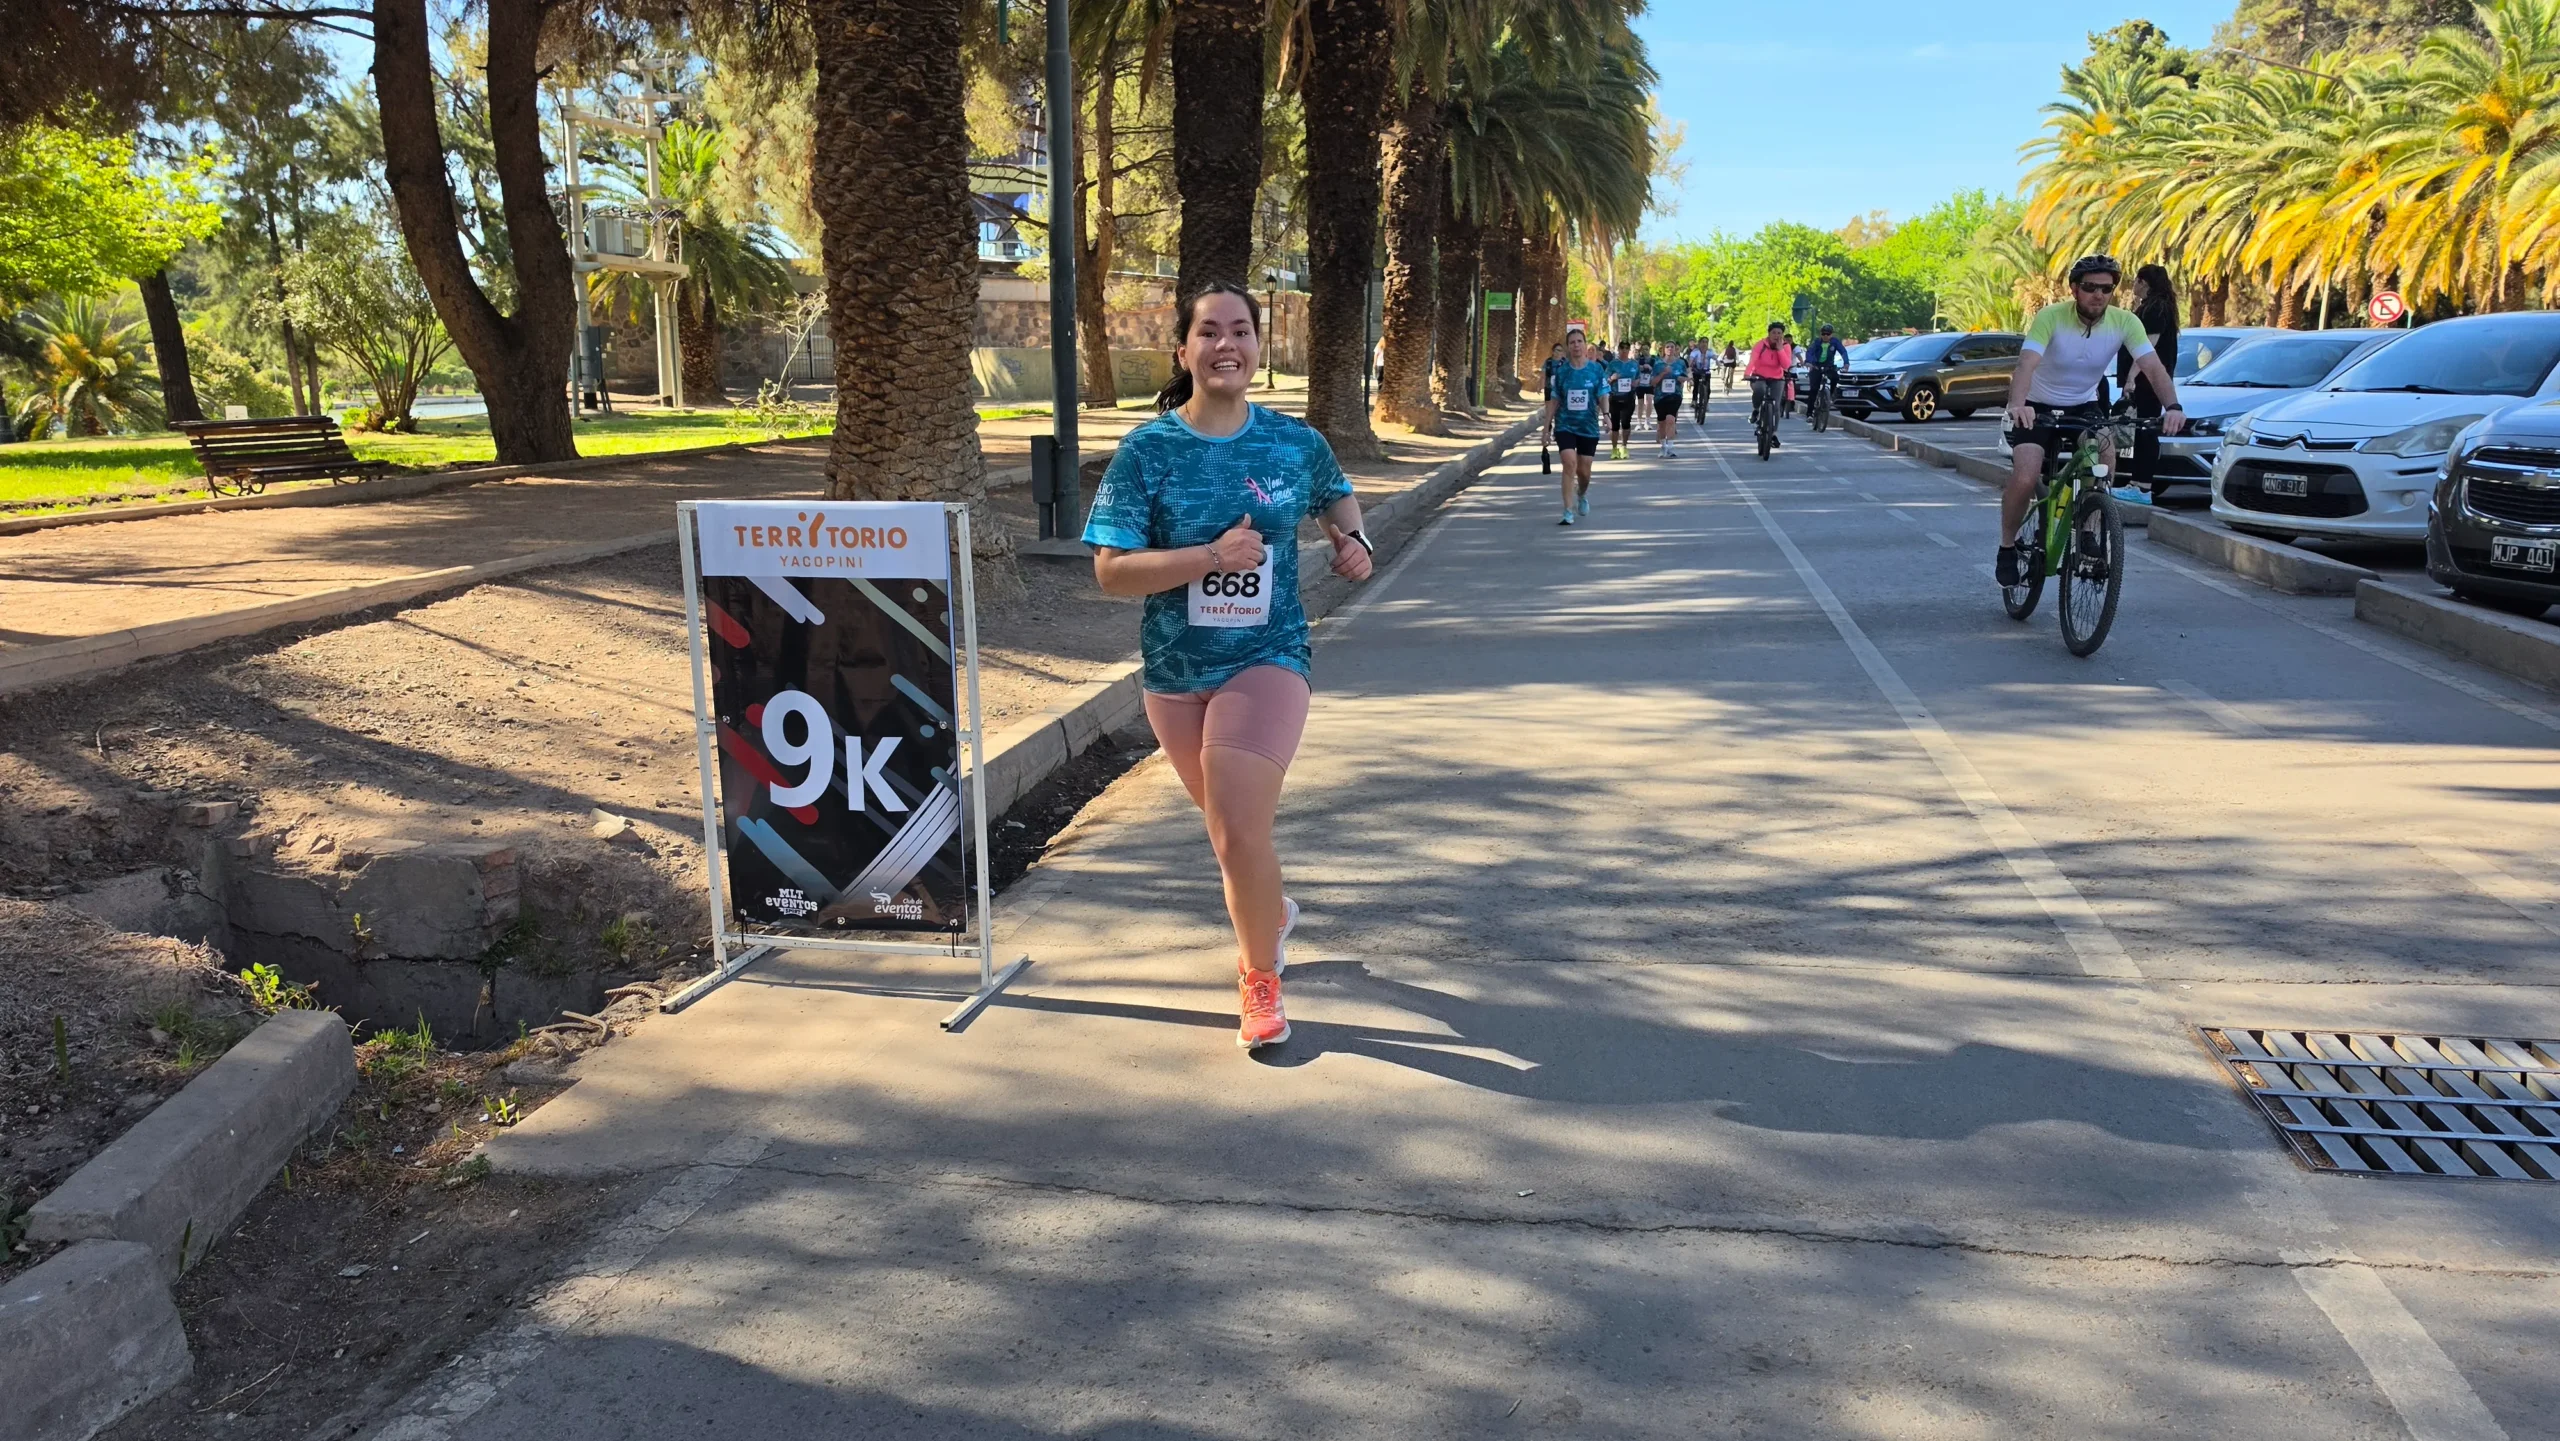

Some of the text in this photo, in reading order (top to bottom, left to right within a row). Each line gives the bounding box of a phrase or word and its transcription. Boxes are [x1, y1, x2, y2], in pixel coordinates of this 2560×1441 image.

[2264, 478, 2305, 494] MNG 914
[780, 555, 863, 568] YACOPINI
[2493, 544, 2551, 567] MJP 441
[1202, 571, 1261, 598] 668
[778, 888, 804, 900] MLT
[874, 904, 923, 914] eventos
